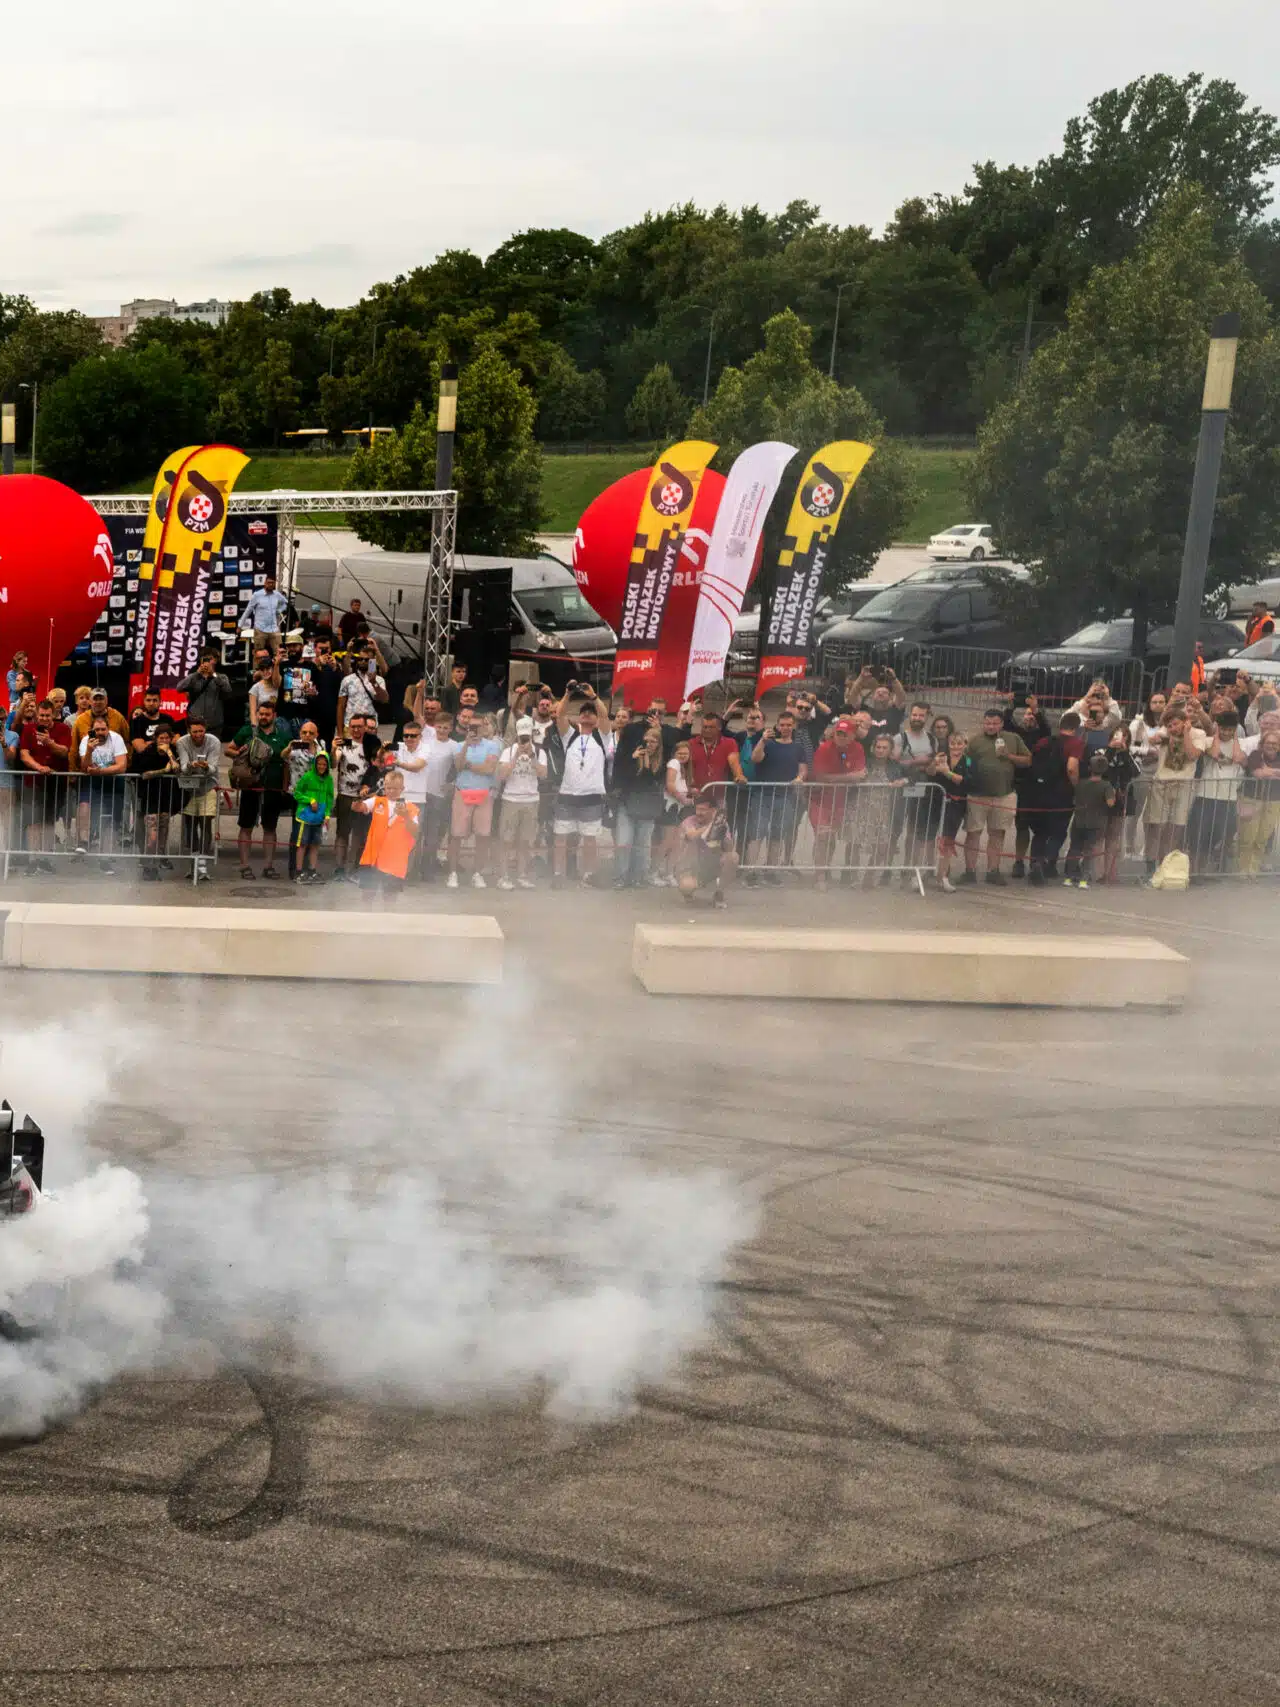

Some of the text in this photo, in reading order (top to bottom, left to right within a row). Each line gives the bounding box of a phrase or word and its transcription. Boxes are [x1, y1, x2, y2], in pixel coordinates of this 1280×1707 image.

[125, 527, 135, 535] FIA
[184, 517, 210, 532] PZM
[657, 503, 680, 515] PZM
[807, 504, 830, 517] PZM
[633, 567, 658, 639] ZWIĄZEK
[646, 544, 677, 639] MOTOROWY
[672, 572, 704, 587] RLE
[778, 570, 807, 645] ZWIĄZEK
[795, 547, 827, 647] MOTOROWY
[135, 600, 151, 662] POLSKI
[167, 593, 191, 677] ZWIĄZEK
[621, 582, 640, 639] POLSKI
[767, 585, 788, 645] POLSKI
[153, 610, 171, 676] POLSKI
[617, 658, 653, 672] pzm.pl
